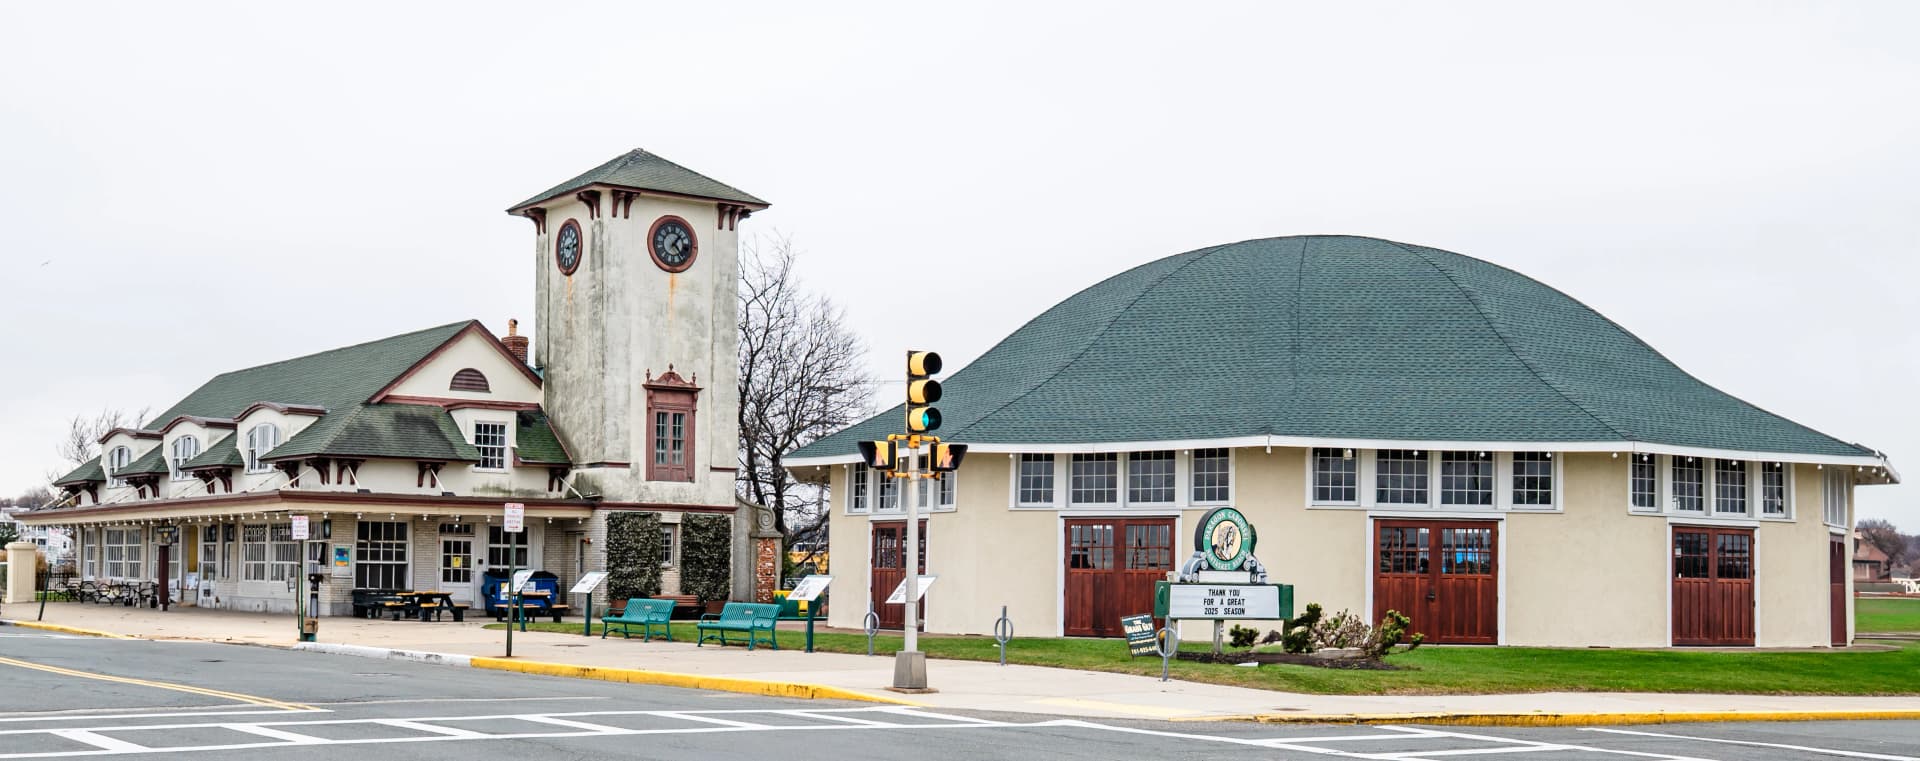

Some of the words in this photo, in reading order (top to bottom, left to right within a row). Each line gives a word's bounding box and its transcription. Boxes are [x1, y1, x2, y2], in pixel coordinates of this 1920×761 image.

[1208, 588, 1226, 597] THANK
[1229, 589, 1241, 597] YOU
[1203, 598, 1215, 606] FOR
[1220, 598, 1224, 606] A
[1227, 598, 1246, 606] GREAT
[1204, 607, 1219, 615] 2025
[1223, 607, 1246, 615] SEASON
